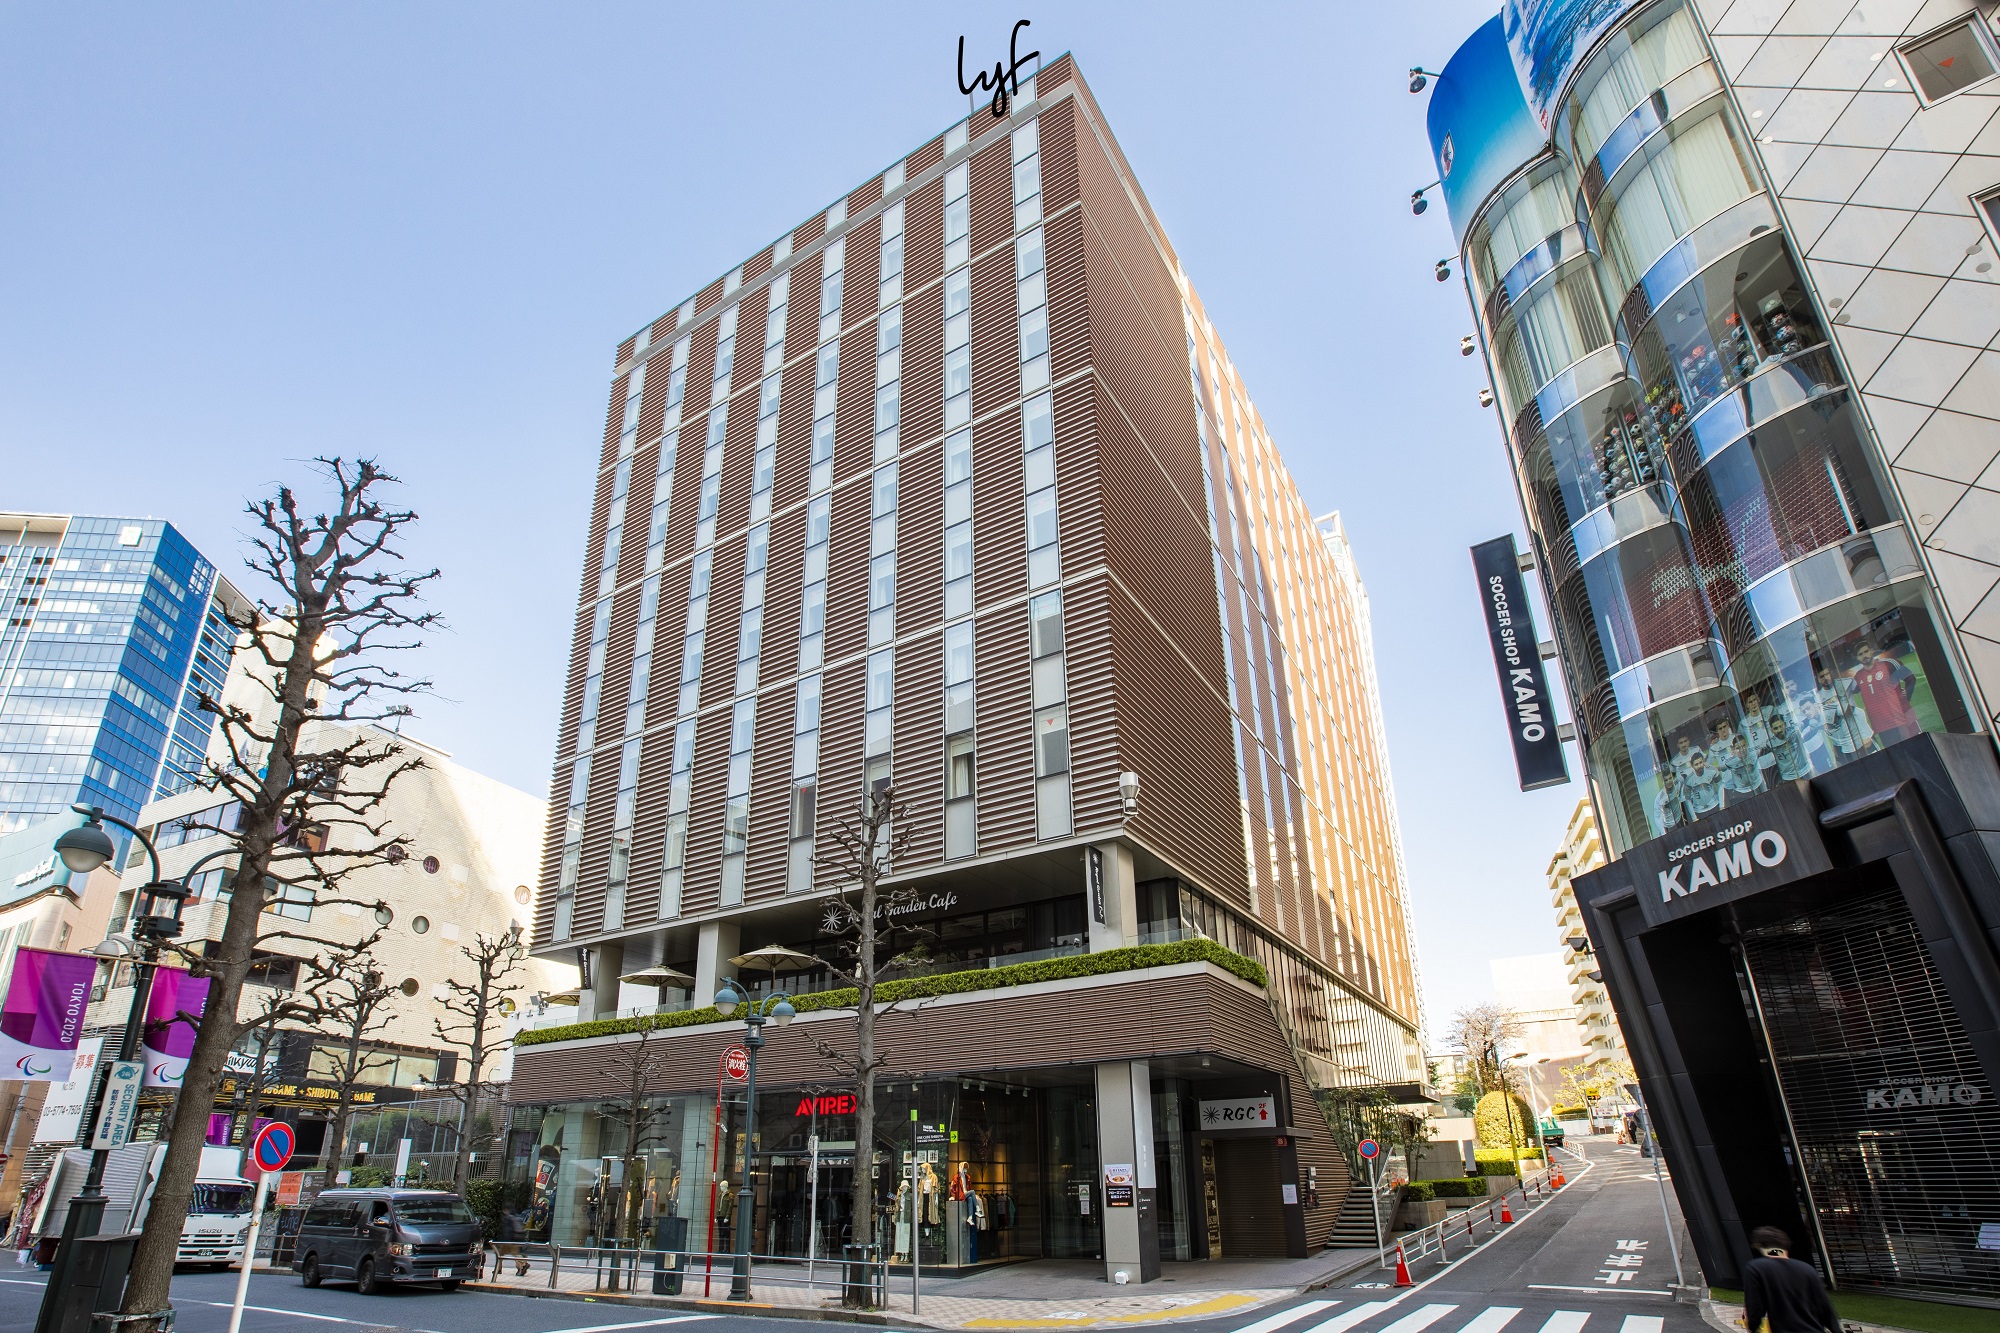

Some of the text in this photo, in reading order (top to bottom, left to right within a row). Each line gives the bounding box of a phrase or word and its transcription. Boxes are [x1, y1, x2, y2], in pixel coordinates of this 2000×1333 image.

[957, 19, 1040, 118] lyf
[1489, 575, 1546, 742] SOCCER SHOP KAMO
[1868, 683, 1875, 695] 1
[1668, 820, 1753, 862] SOCCER SHOP
[1657, 830, 1788, 903] KAMO
[929, 891, 957, 911] Cafe
[60, 982, 86, 1043] TOKYO 2020
[75, 1053, 96, 1070] 募集
[1878, 1075, 1956, 1086] SOCCER SHOP
[305, 1087, 340, 1100] SHIBUYA
[1866, 1084, 1982, 1109] KAMO
[110, 1083, 136, 1146] SECURITY AREA
[1222, 1106, 1256, 1121] RGC
